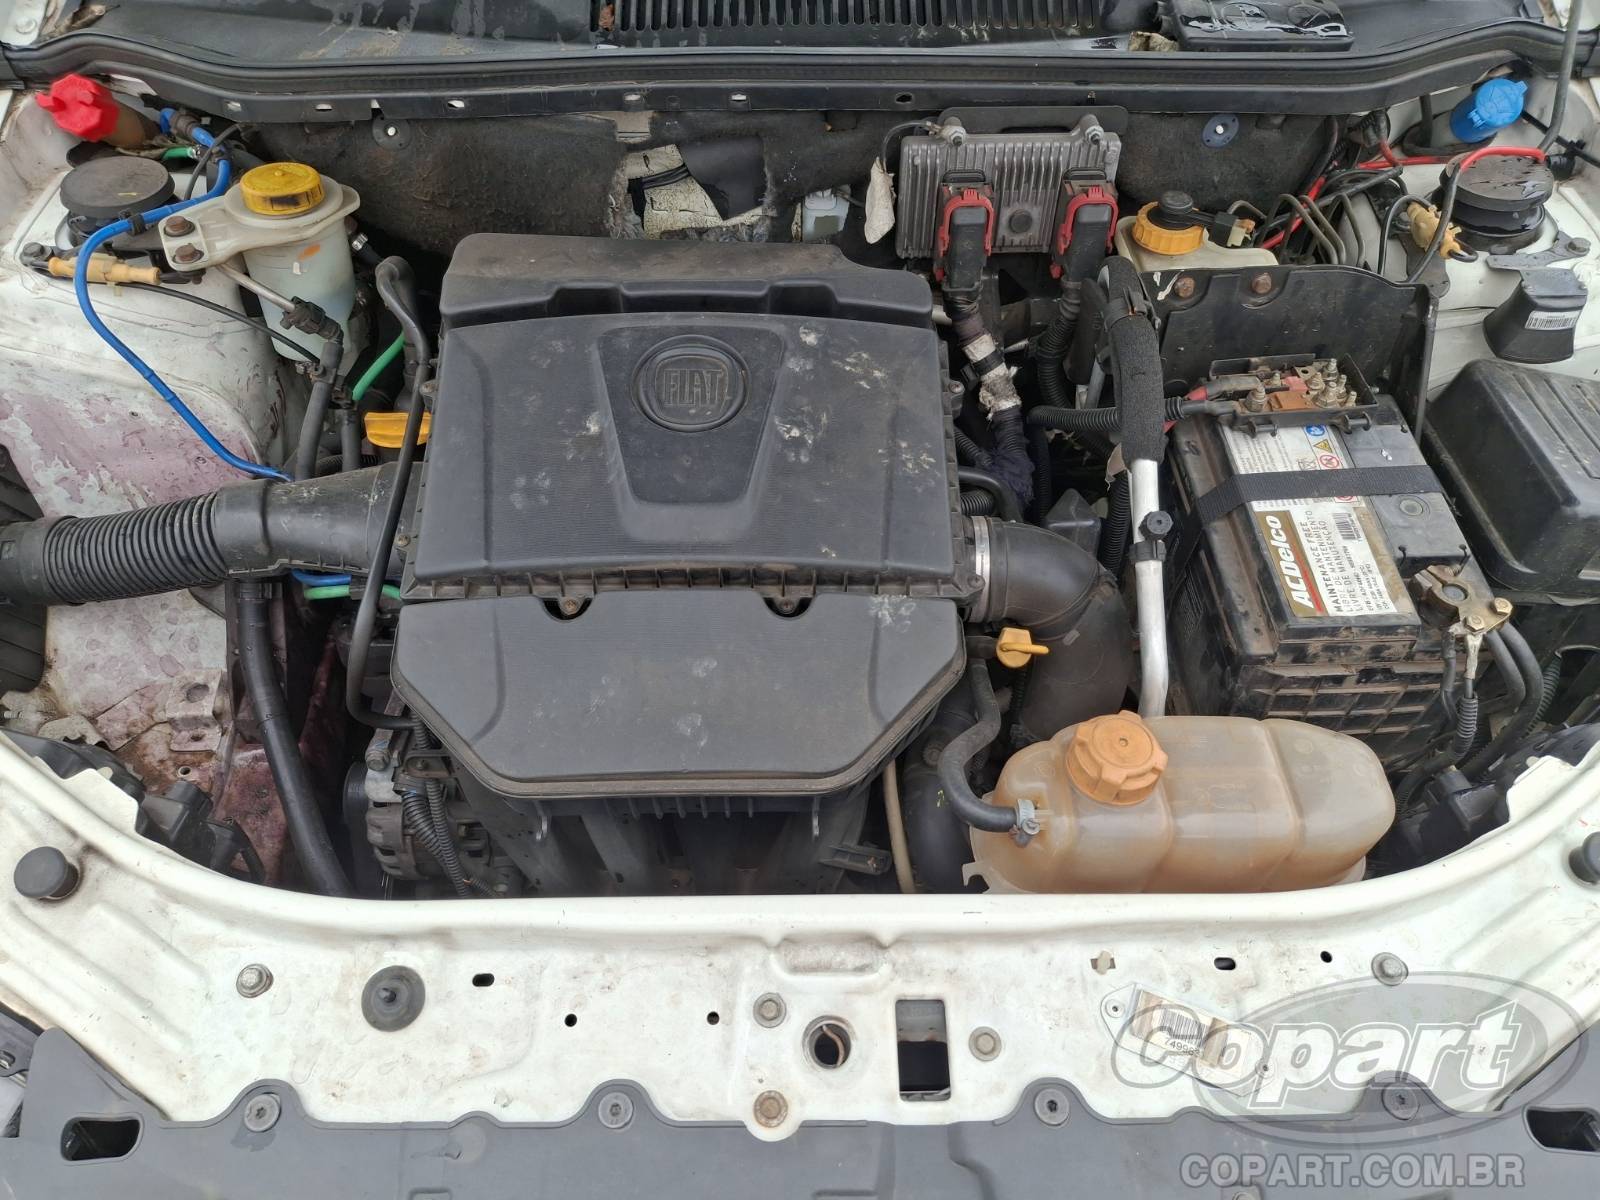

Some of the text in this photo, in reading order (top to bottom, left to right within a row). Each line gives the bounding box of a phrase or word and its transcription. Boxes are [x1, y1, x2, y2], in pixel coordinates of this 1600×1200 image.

[663, 368, 723, 407] FIAT
[1265, 515, 1314, 608] ACDelco
[1299, 520, 1344, 612] MAINTENANCE FREE
[1303, 510, 1353, 612] LIBRE DE MANTENIMIENTO
[1317, 520, 1347, 572] MANUTENÇÃO
[1340, 575, 1352, 585] DE
[1345, 586, 1364, 611] LIVRE
